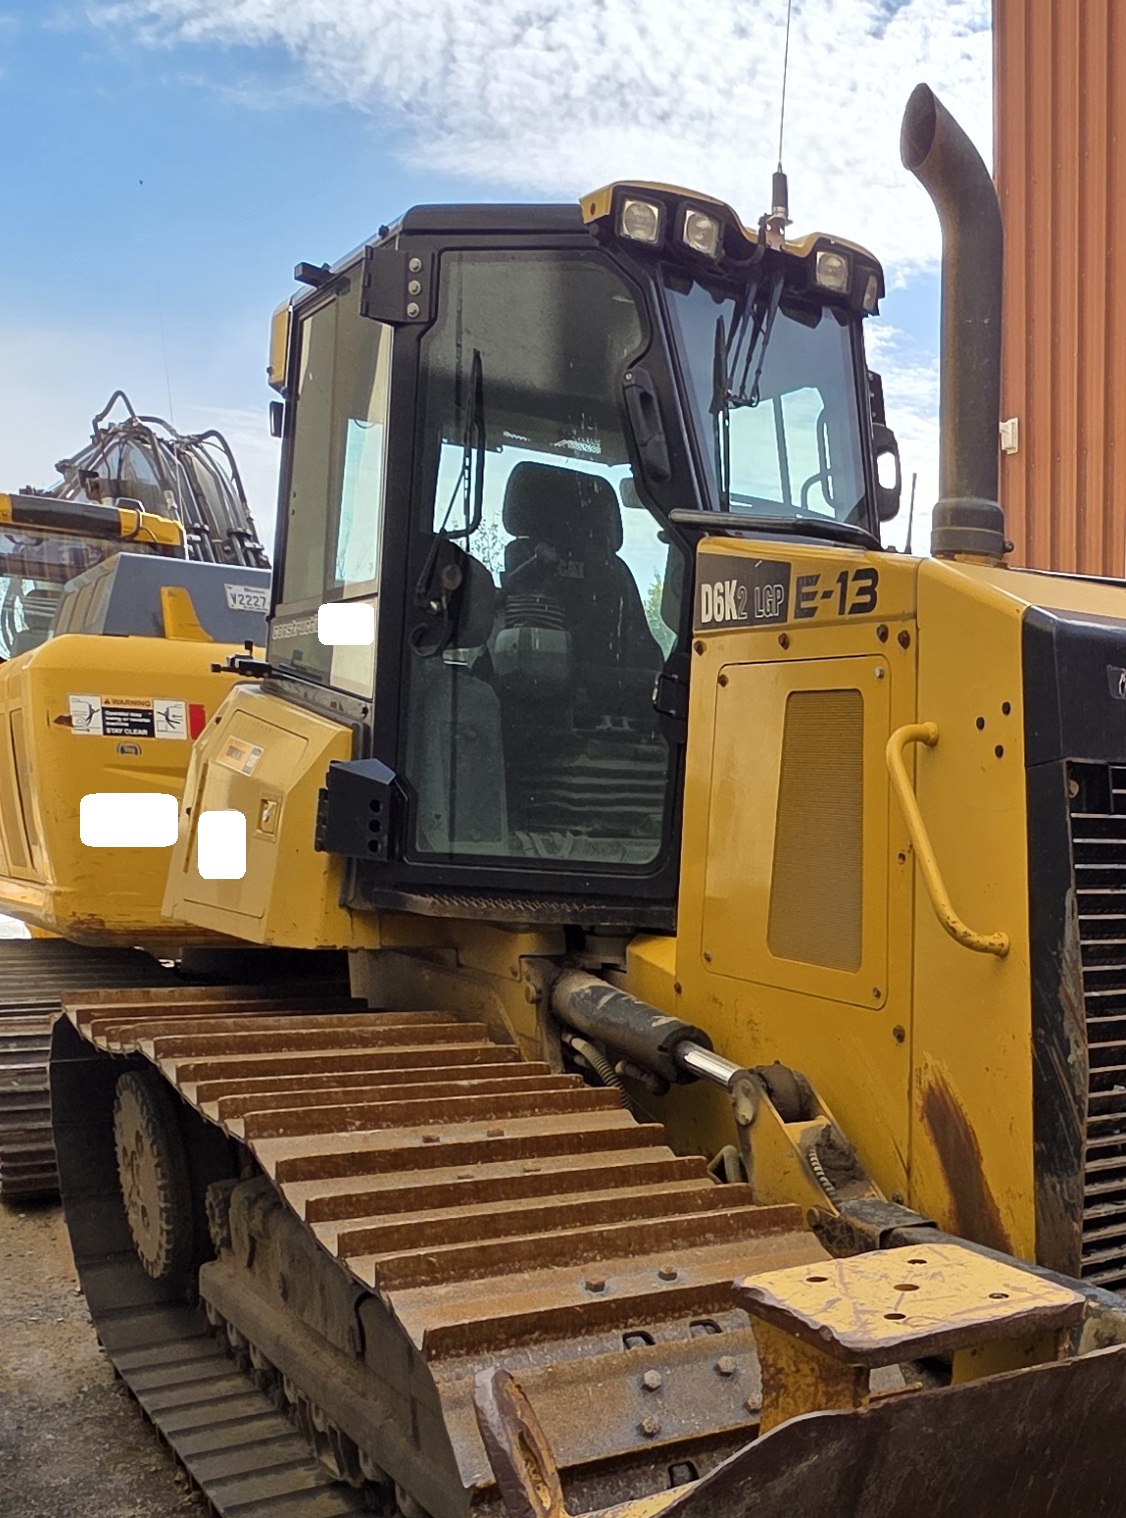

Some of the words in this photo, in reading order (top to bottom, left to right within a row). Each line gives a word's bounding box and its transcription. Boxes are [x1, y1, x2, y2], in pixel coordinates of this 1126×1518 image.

[558, 559, 586, 579] CAT
[754, 584, 785, 619] LGP
[794, 567, 879, 620] E-13
[111, 698, 151, 707] WARNING
